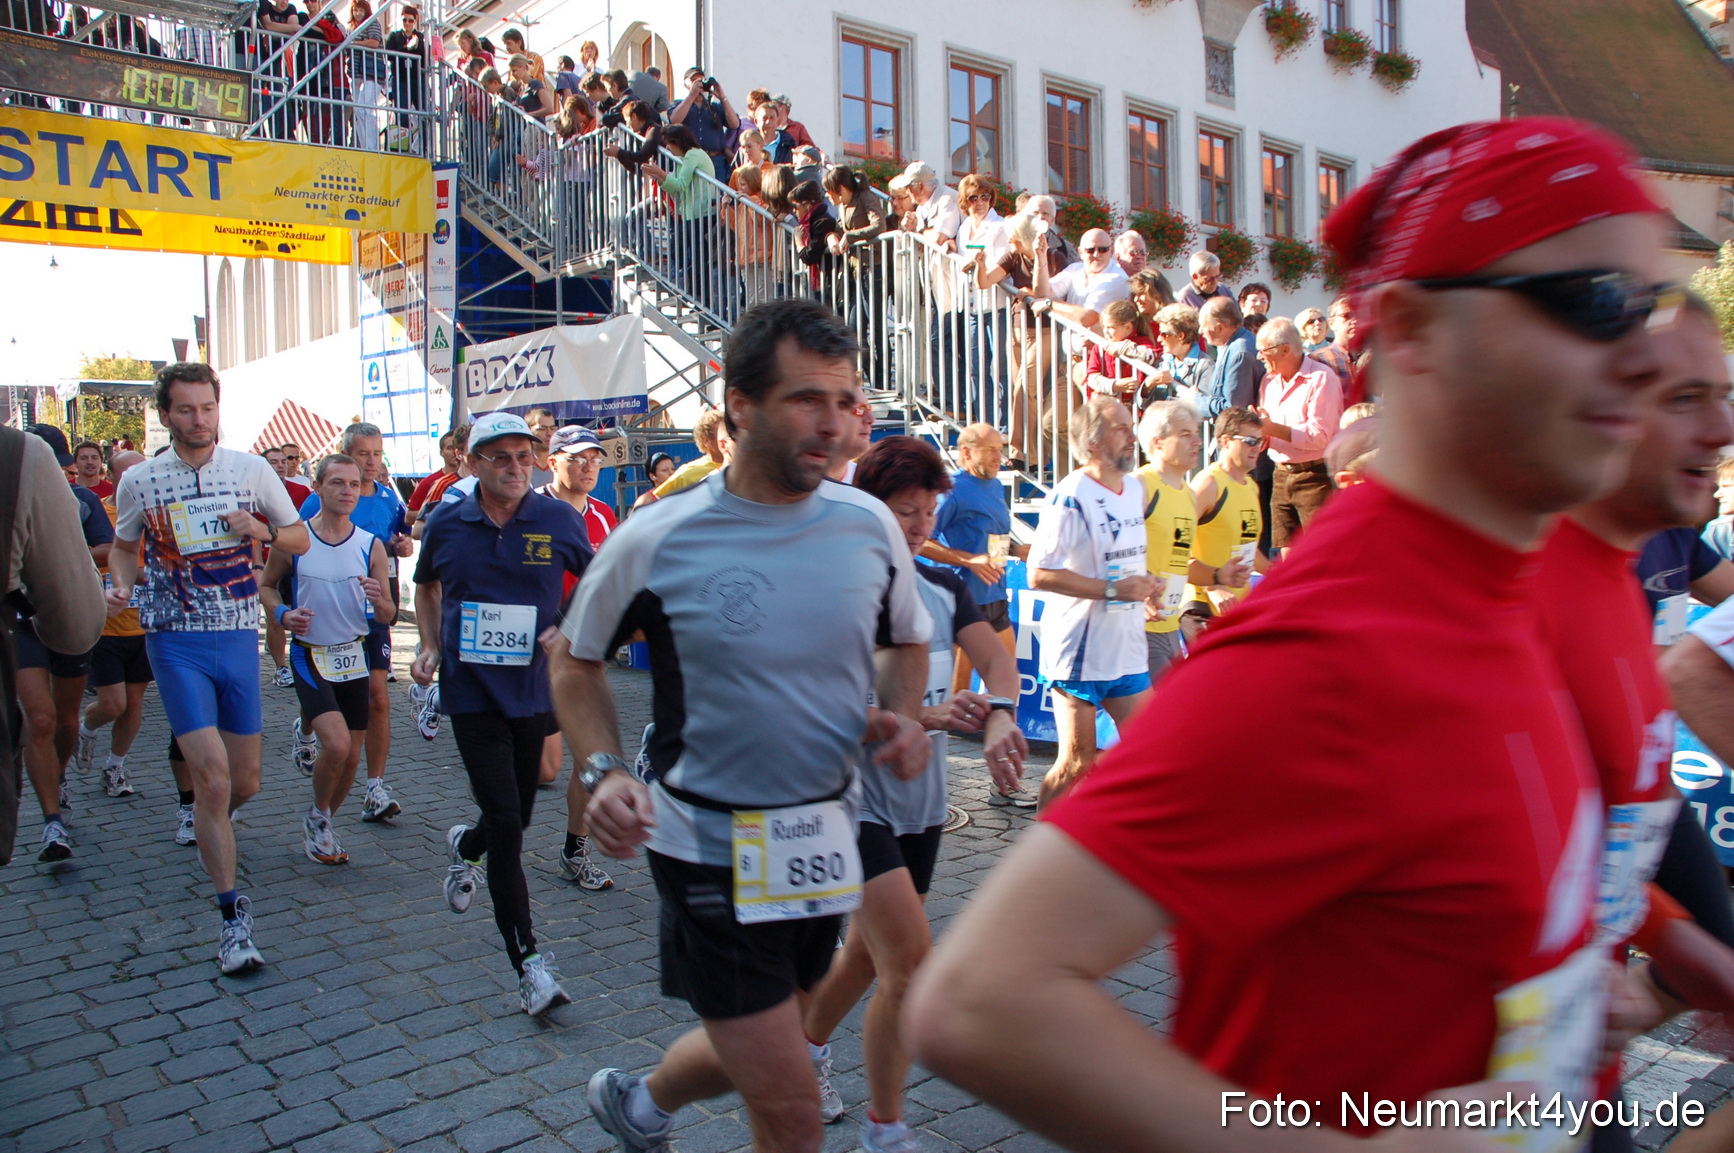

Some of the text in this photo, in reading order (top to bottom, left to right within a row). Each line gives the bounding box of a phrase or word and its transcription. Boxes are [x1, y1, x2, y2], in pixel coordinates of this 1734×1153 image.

[80, 48, 241, 82] Elektronische Sportstätteneinrichtungen
[0, 126, 232, 201] START
[274, 186, 400, 208] Neumarkter Stadtlauf
[466, 345, 555, 397] BOCK
[187, 501, 228, 515] Christian
[200, 518, 231, 536] 170
[481, 608, 502, 621] Karl
[326, 643, 354, 654] Andreas
[481, 630, 528, 649] 2384
[334, 654, 358, 670] 307
[771, 814, 824, 841] Rudolf
[787, 851, 846, 887] 880
